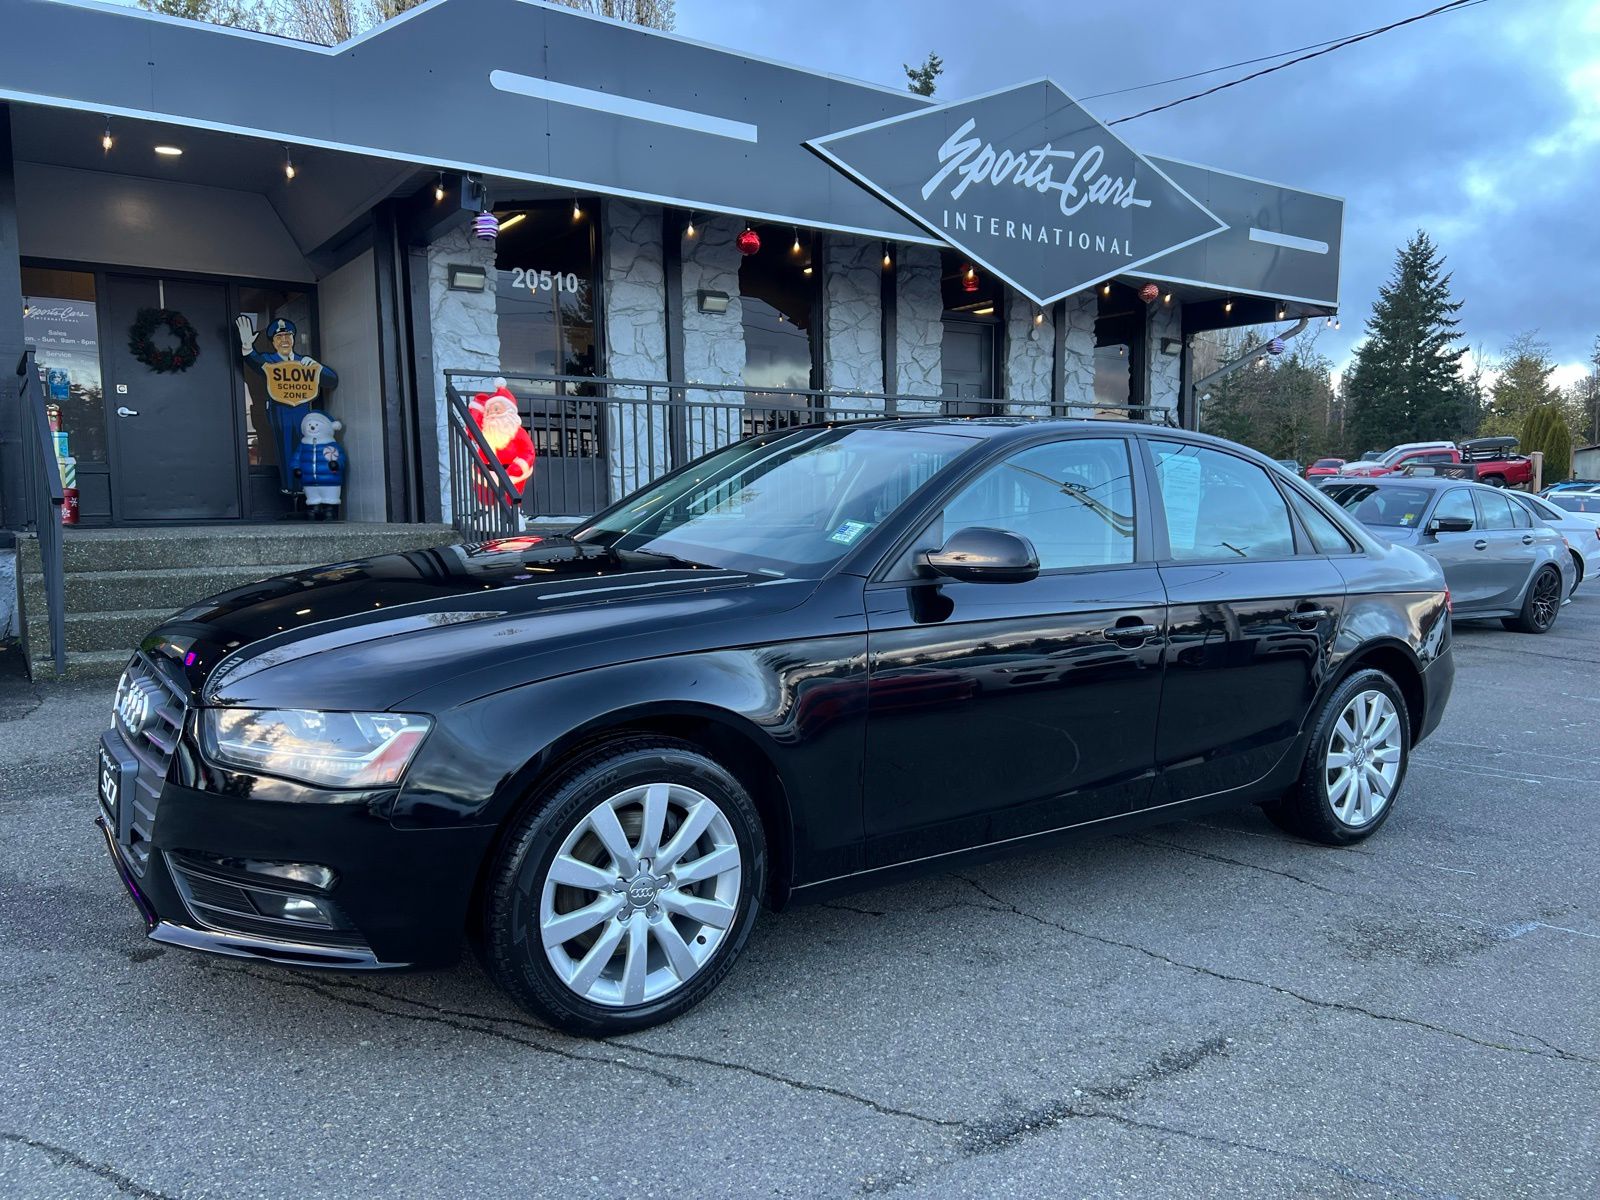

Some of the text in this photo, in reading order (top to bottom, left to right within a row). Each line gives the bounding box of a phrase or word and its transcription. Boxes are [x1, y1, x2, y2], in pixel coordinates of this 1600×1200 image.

[921, 117, 1151, 217] Sports Cars
[943, 210, 1133, 257] INTERNATIONAL
[511, 267, 578, 293] 20510
[273, 368, 316, 382] SLOW
[277, 383, 313, 391] SCHOOL
[283, 391, 307, 399] ZONE
